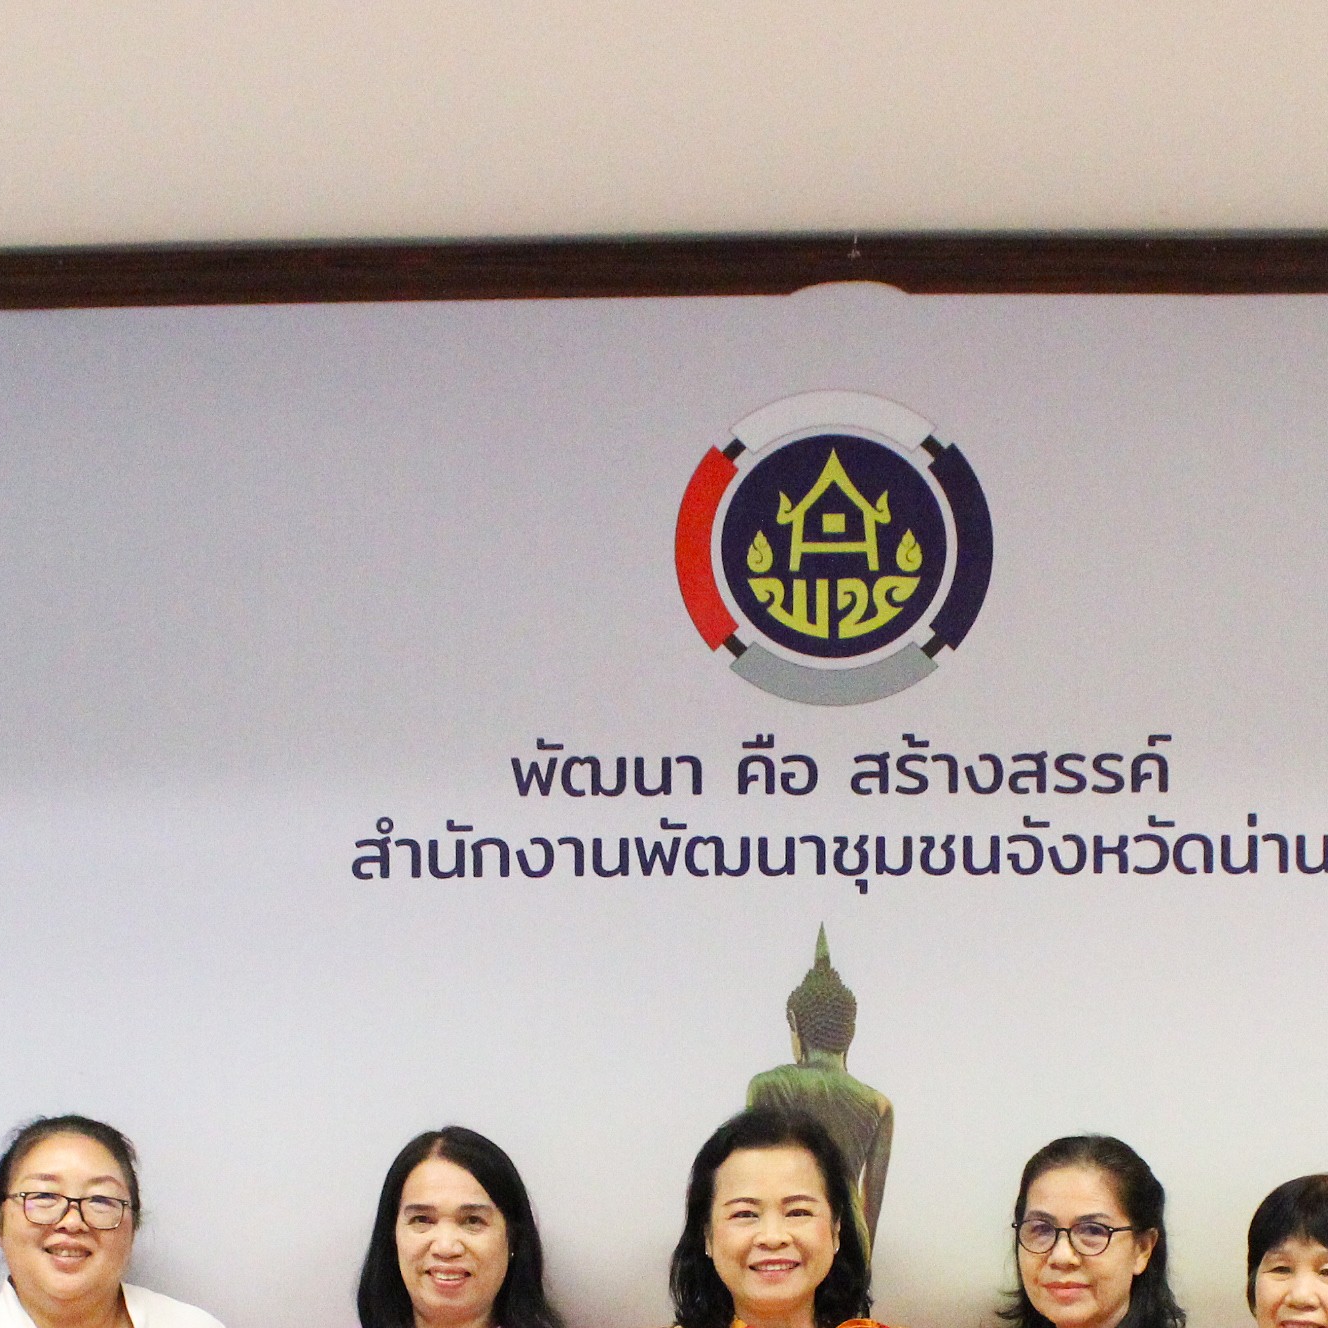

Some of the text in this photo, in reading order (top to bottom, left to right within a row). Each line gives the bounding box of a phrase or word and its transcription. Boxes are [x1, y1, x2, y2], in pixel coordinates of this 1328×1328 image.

[512, 734, 1170, 798] พัฒนา คือ สร้างสรรค์
